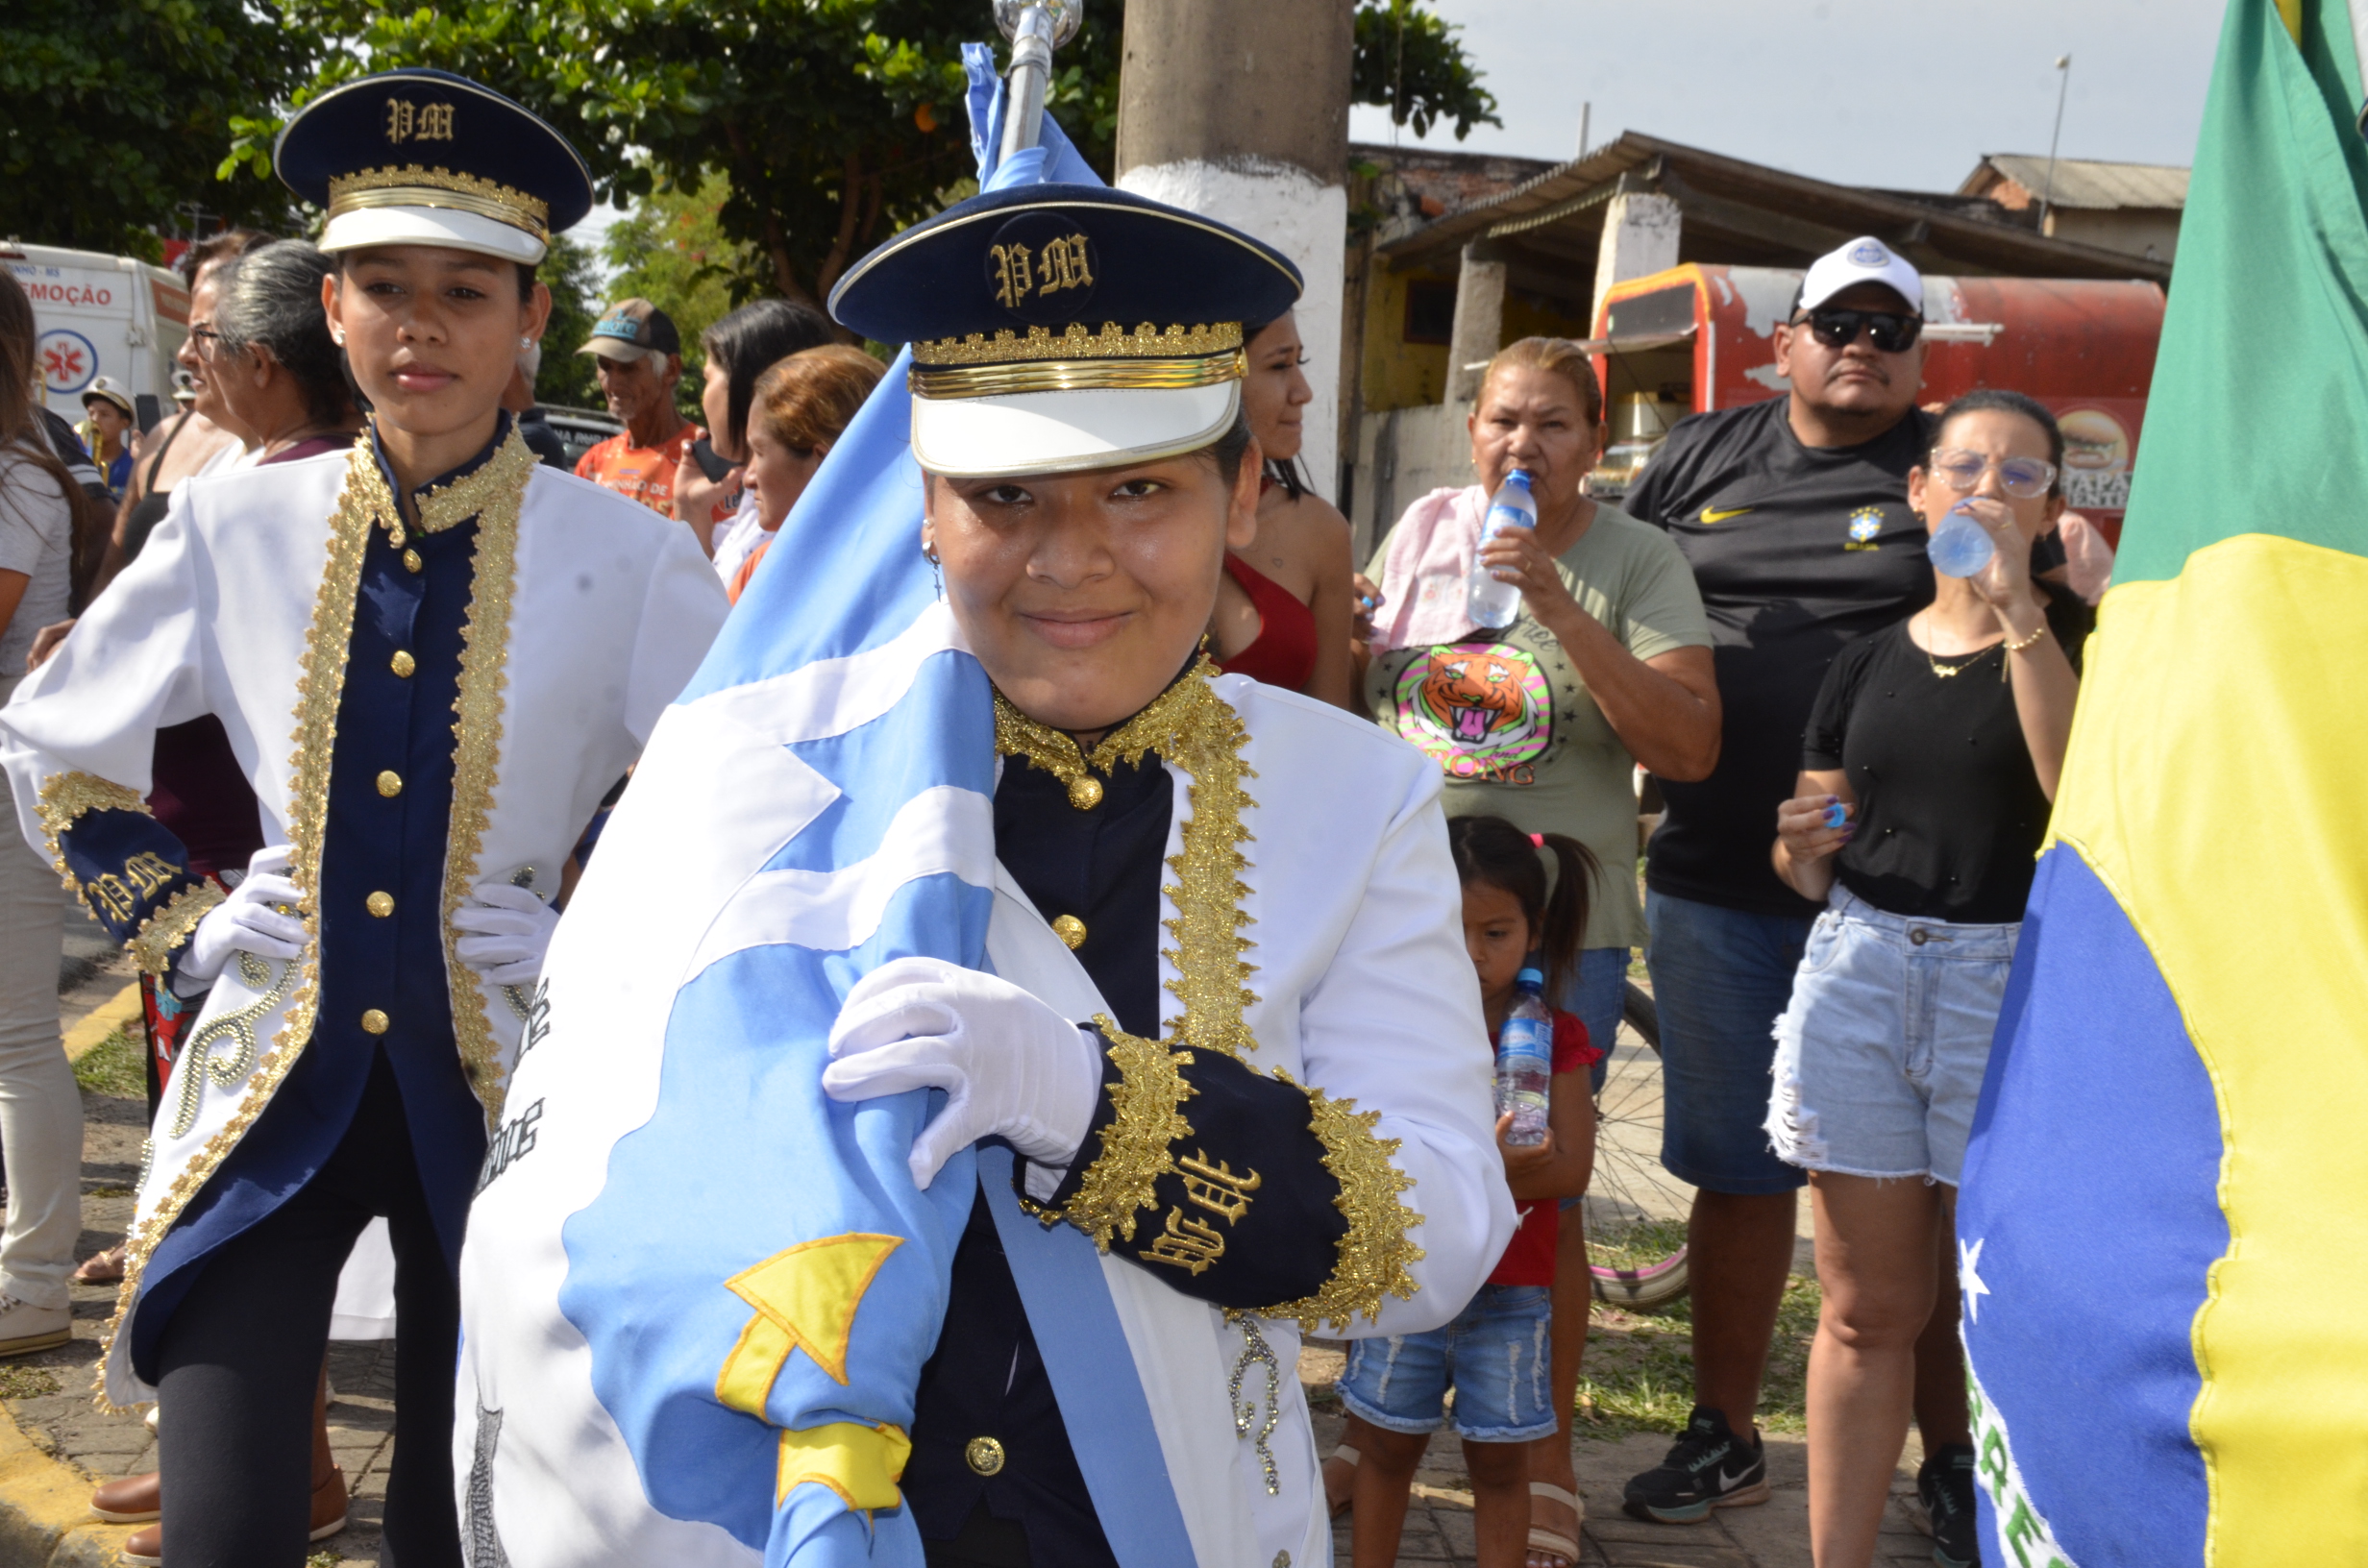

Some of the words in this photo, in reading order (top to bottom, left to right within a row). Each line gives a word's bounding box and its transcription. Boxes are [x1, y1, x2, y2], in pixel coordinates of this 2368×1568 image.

[386, 97, 456, 144] PM
[990, 233, 1094, 307] PM
[650, 482, 669, 497] DE
[1423, 748, 1536, 785] RONG
[87, 851, 183, 923] PM
[1139, 1147, 1262, 1277] PM
